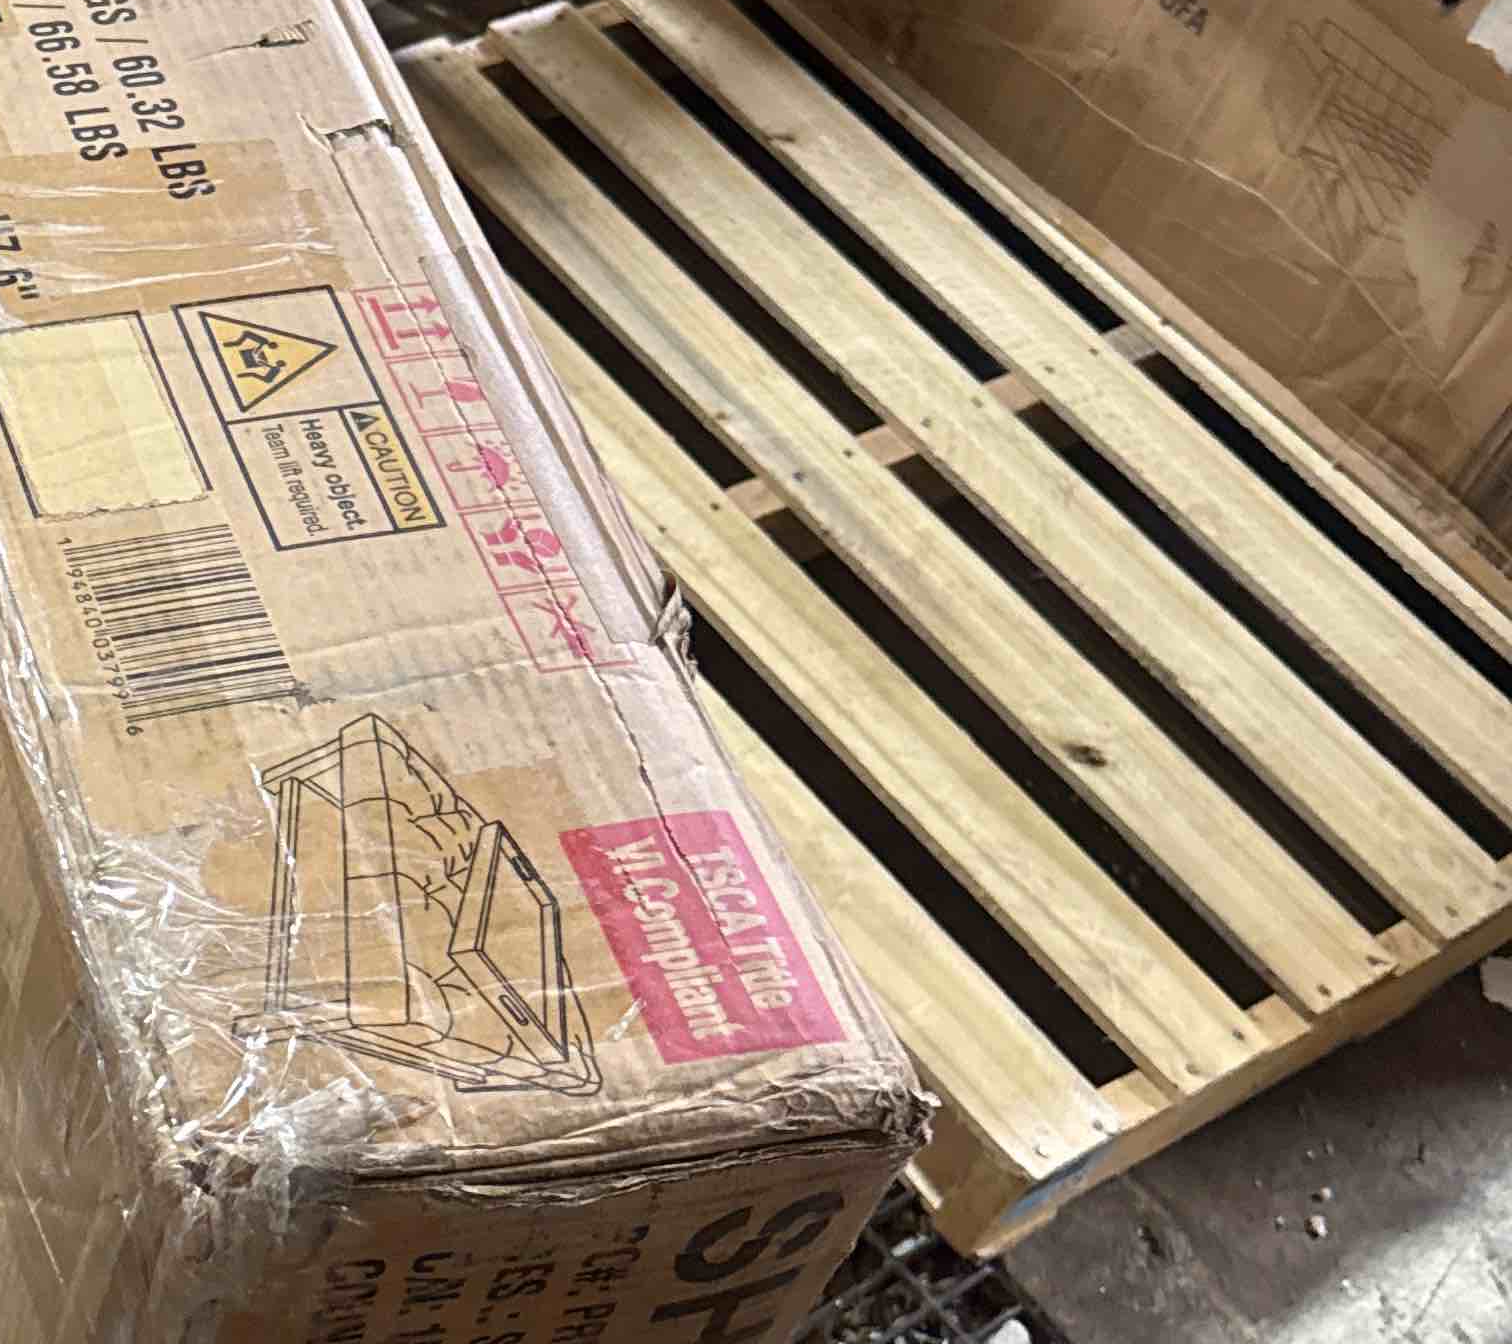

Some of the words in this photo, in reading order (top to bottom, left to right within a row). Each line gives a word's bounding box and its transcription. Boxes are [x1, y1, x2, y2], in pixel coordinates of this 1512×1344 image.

[27, 18, 101, 98] 66.58
[64, 106, 129, 164] LBS
[111, 54, 186, 133] 60.32
[150, 142, 217, 201] LBS
[261, 423, 291, 460] Team
[277, 460, 303, 478] lift
[298, 417, 337, 469] Heavy
[324, 473, 368, 531] object.
[364, 431, 427, 522] CAUTION
[284, 477, 329, 537] required.
[685, 845, 768, 937] TSCA
[623, 877, 746, 1041] Compliant
